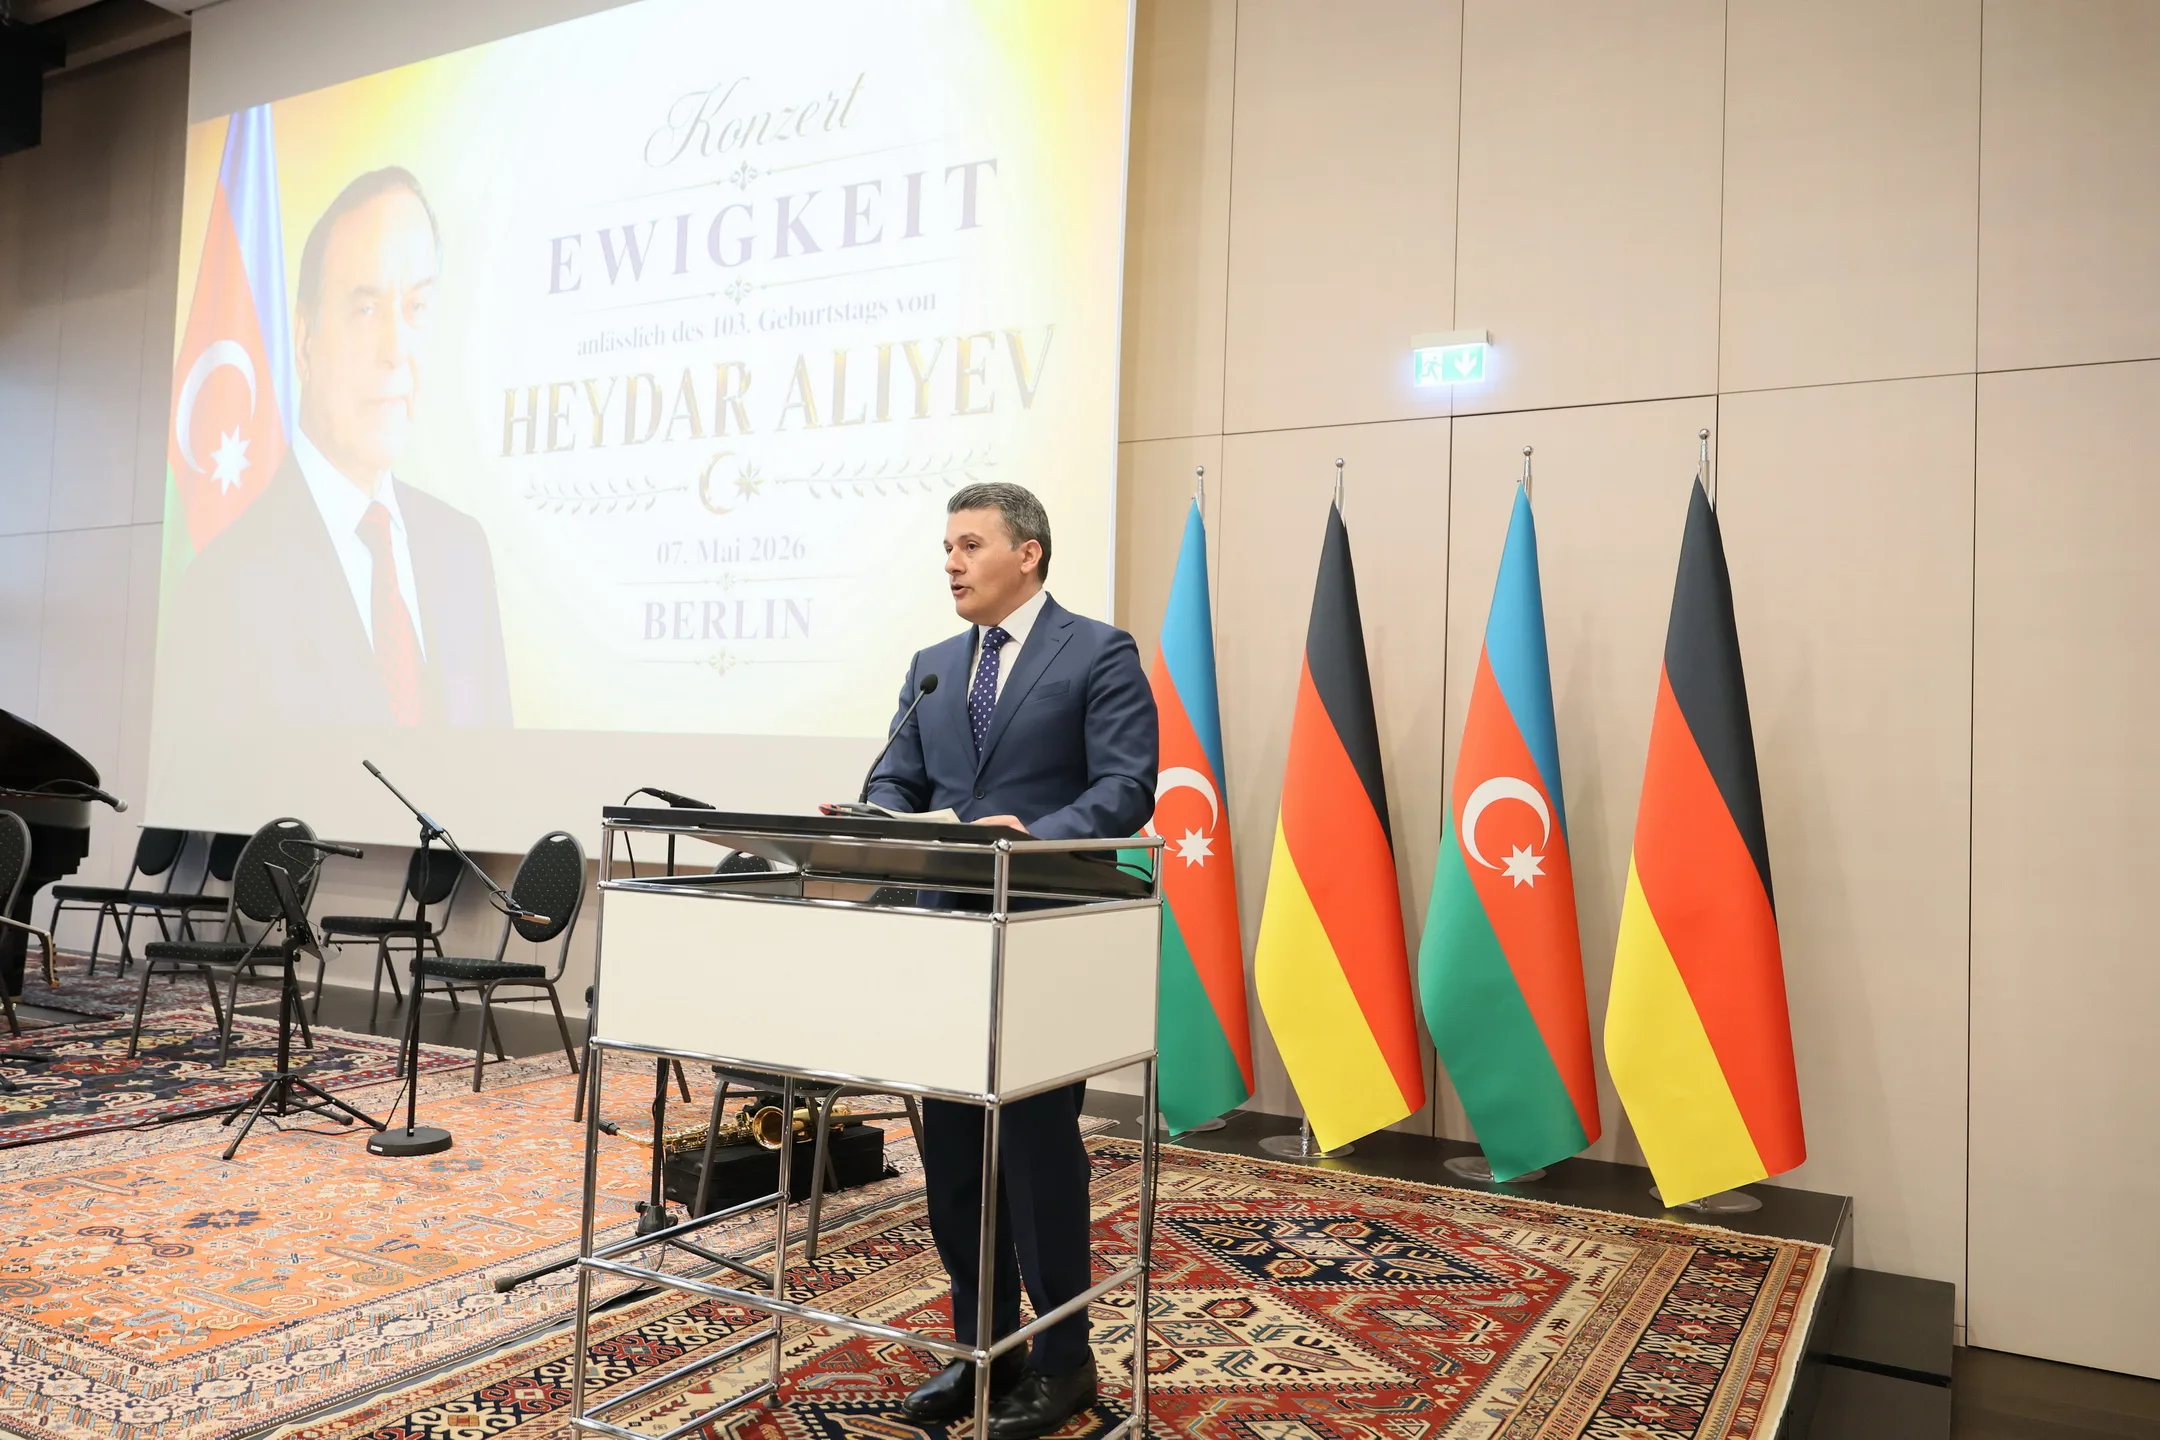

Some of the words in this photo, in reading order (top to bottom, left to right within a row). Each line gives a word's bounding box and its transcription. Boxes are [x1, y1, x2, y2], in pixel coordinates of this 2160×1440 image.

[644, 72, 866, 169] Konzert
[547, 157, 998, 295] EWIGKEIT
[577, 323, 666, 356] anlässlich
[672, 320, 704, 344] des
[713, 311, 751, 339] 103.
[758, 298, 889, 332] Geburtstags
[895, 292, 937, 314] von
[499, 359, 756, 458] HEYDAR
[773, 322, 1058, 434] ALIYEV
[656, 541, 688, 566] 07.
[698, 537, 741, 564] Mai
[748, 533, 807, 562] 2026
[641, 597, 814, 641] BERLIN
